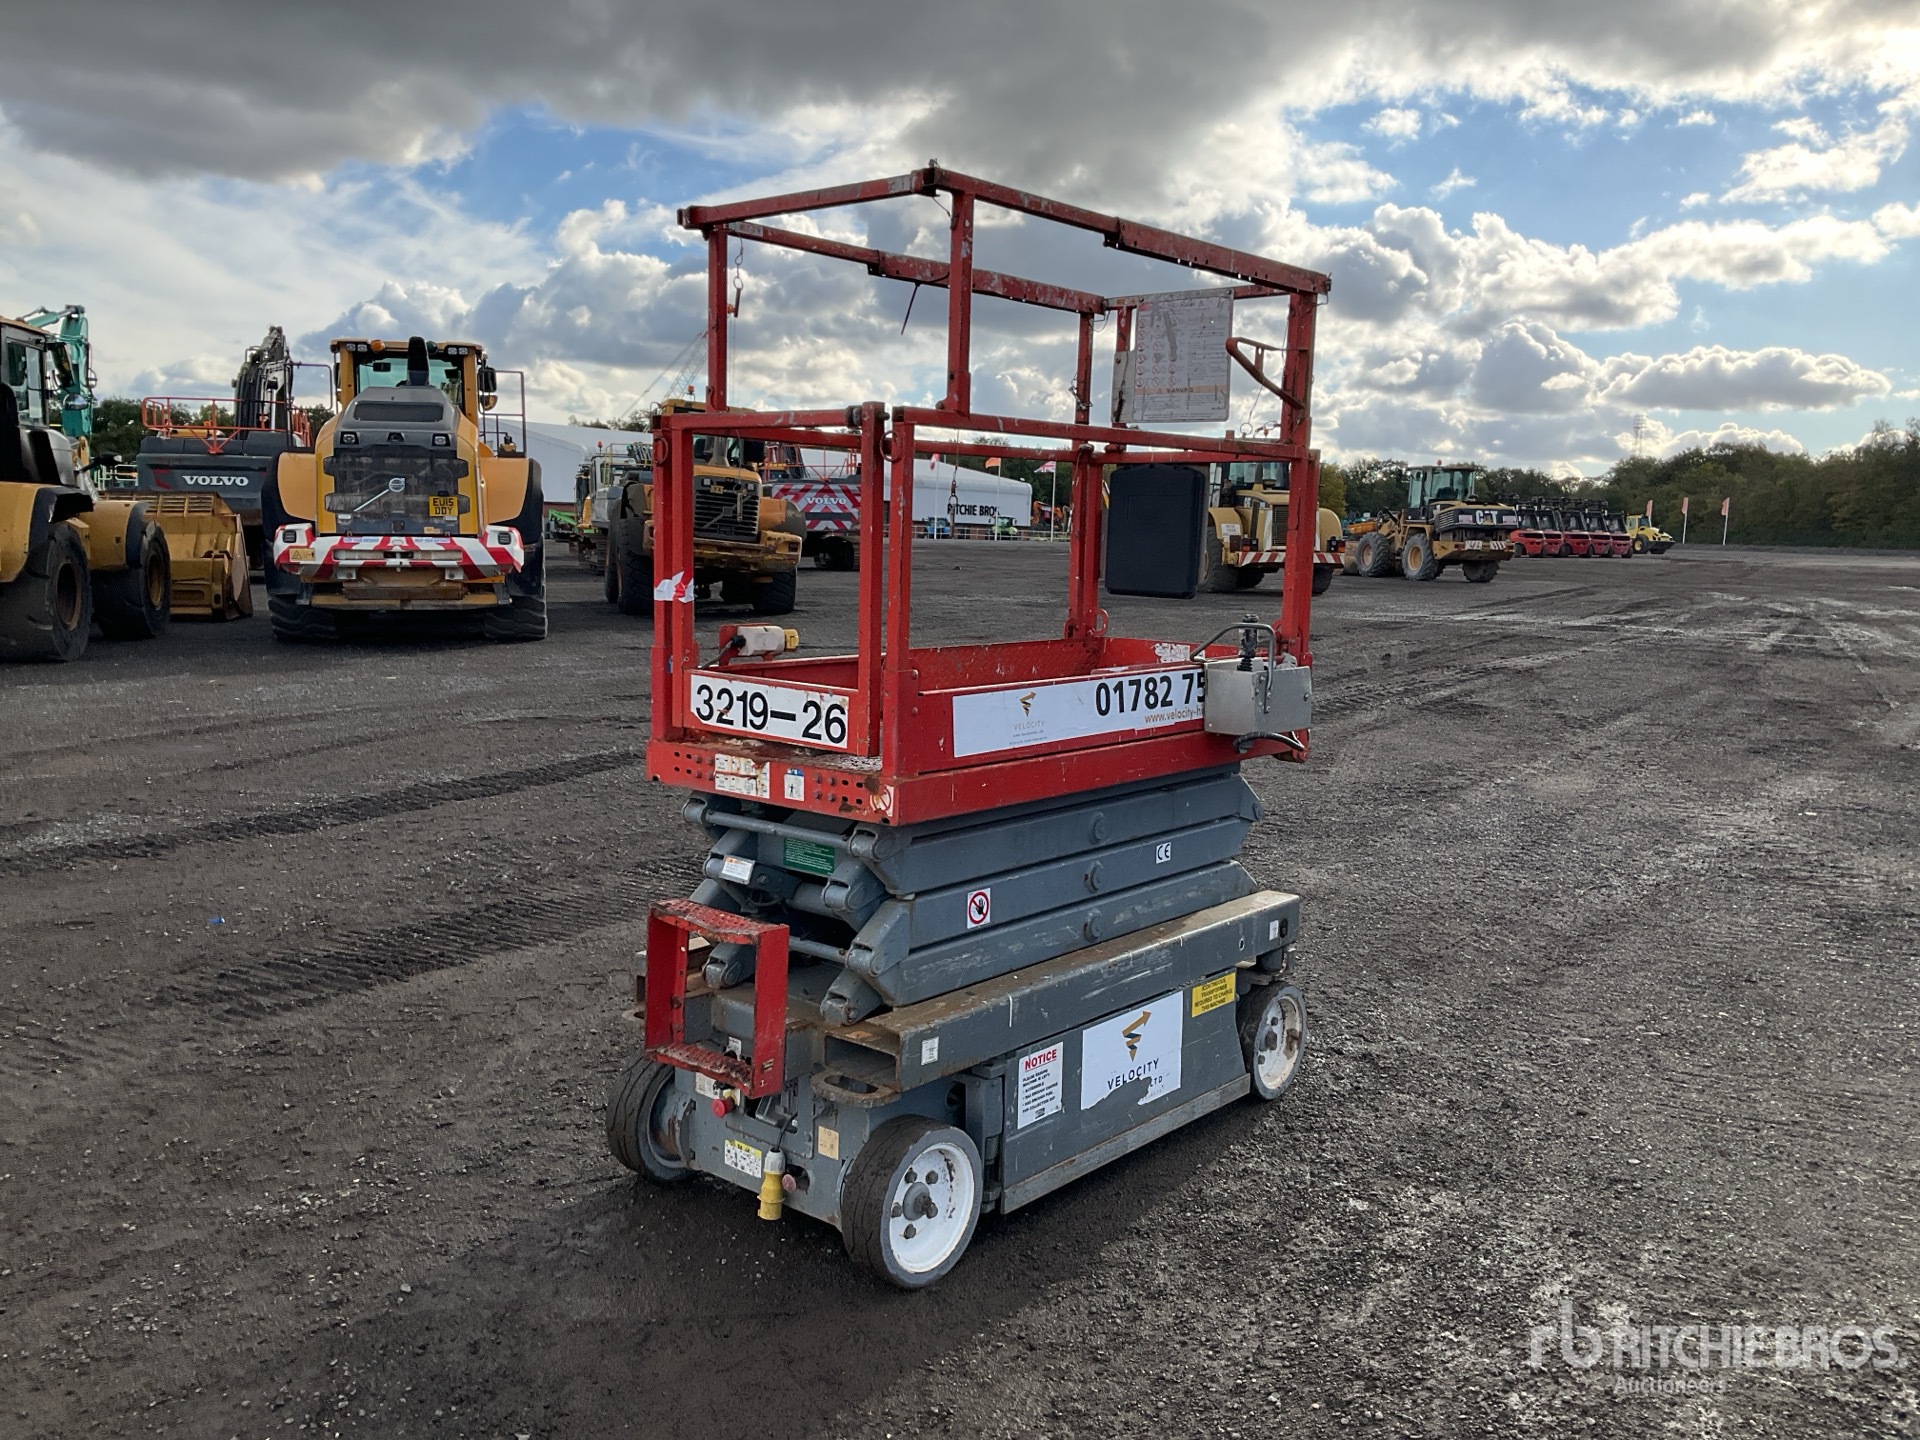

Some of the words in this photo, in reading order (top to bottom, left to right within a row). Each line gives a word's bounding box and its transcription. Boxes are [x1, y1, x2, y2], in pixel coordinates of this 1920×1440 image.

[182, 475, 249, 487] VOLVO
[805, 497, 847, 505] VOLVO
[1095, 675, 1173, 716] 01782
[1182, 672, 1205, 705] 75
[1013, 720, 1045, 731] VELOCITY
[1025, 1049, 1057, 1070] NOTICE
[1107, 1058, 1159, 1089] VELOCITY
